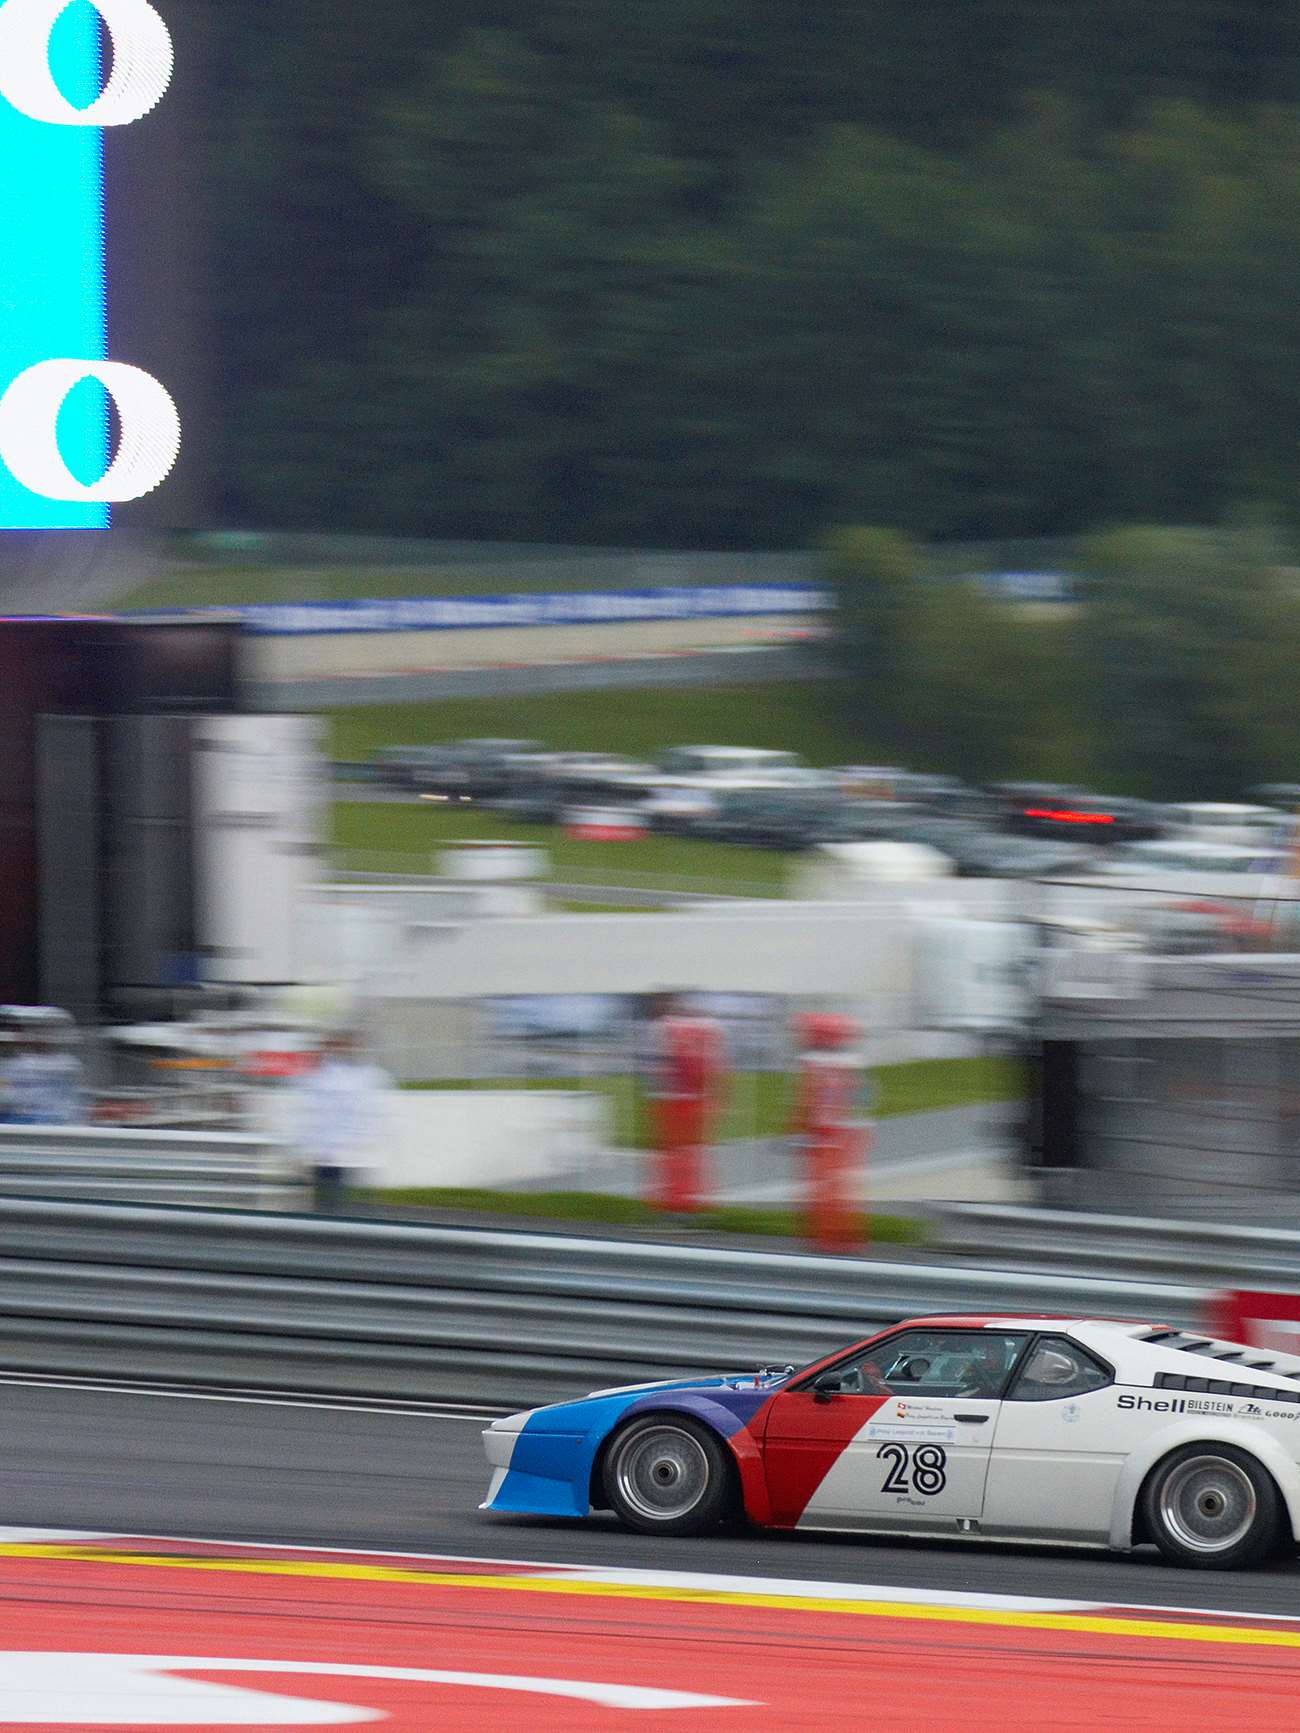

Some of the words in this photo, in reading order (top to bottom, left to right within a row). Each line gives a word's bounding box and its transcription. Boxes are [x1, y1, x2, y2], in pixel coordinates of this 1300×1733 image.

[1117, 1395, 1185, 1413] Shell
[1187, 1400, 1233, 1412] BILSTEIN
[876, 1442, 946, 1496] 28
